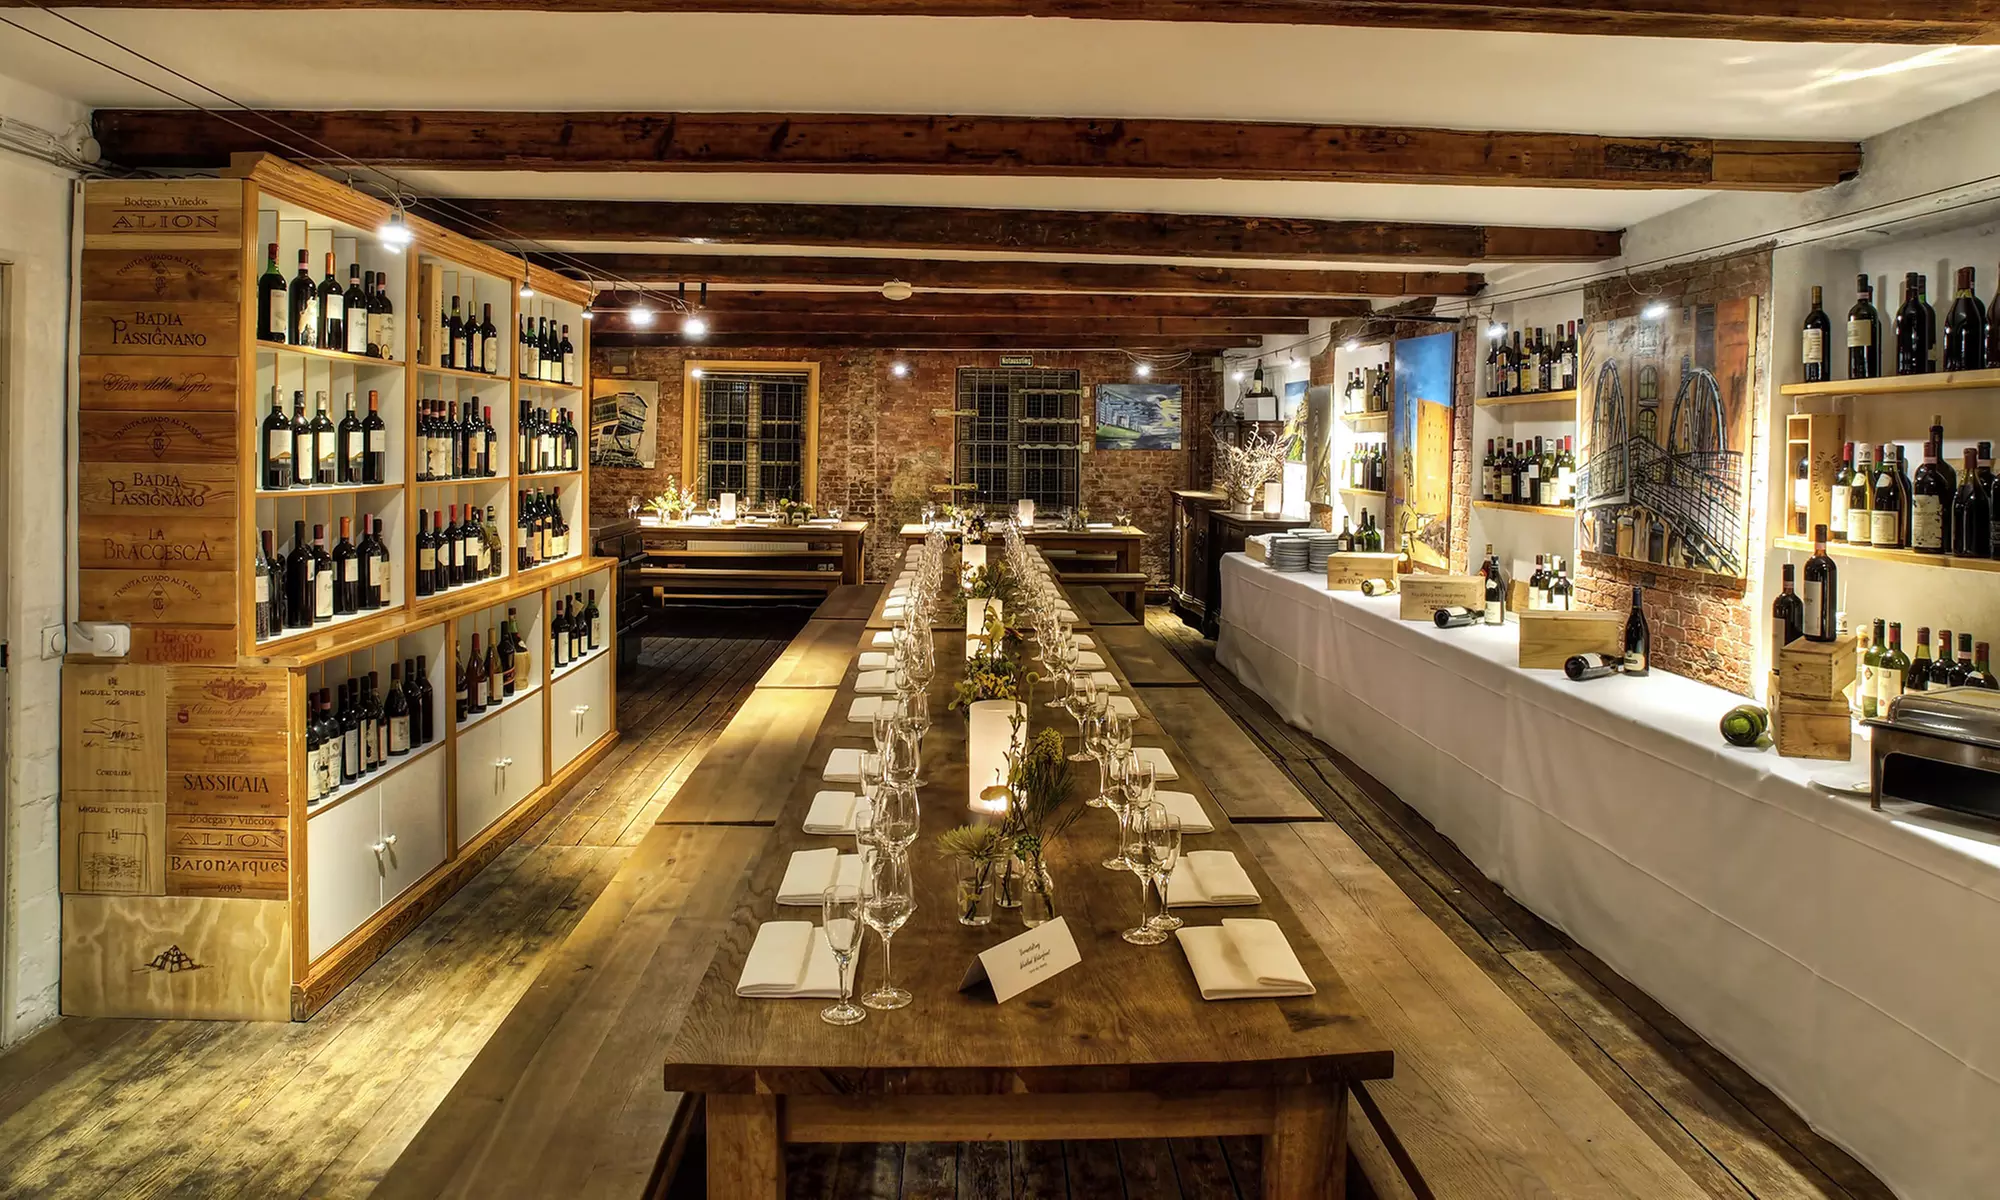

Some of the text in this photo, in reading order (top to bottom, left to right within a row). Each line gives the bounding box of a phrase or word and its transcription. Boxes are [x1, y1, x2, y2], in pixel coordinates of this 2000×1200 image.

[124, 197, 208, 208] Bodegas y Viñedos
[112, 215, 218, 228] ALION
[116, 258, 144, 276] TENUTA
[136, 311, 183, 326] BADIA
[108, 316, 207, 346] PASSIGNANO
[113, 420, 141, 440] TENUTA
[142, 416, 170, 424] GUADO
[181, 422, 202, 440] TASSO
[133, 472, 181, 487] BADIA
[108, 478, 205, 508] PASSIGNANO
[149, 528, 165, 540] LA
[103, 538, 212, 562] BRACCESCA
[113, 578, 141, 598] TENUTA
[142, 575, 170, 583] GUADO
[181, 580, 202, 600] TASSO
[183, 773, 269, 793] SASSICAIA
[78, 806, 148, 815] MIGUEL TORRES
[189, 815, 276, 826] Bodegas y Viñedos
[177, 832, 285, 848] ALION
